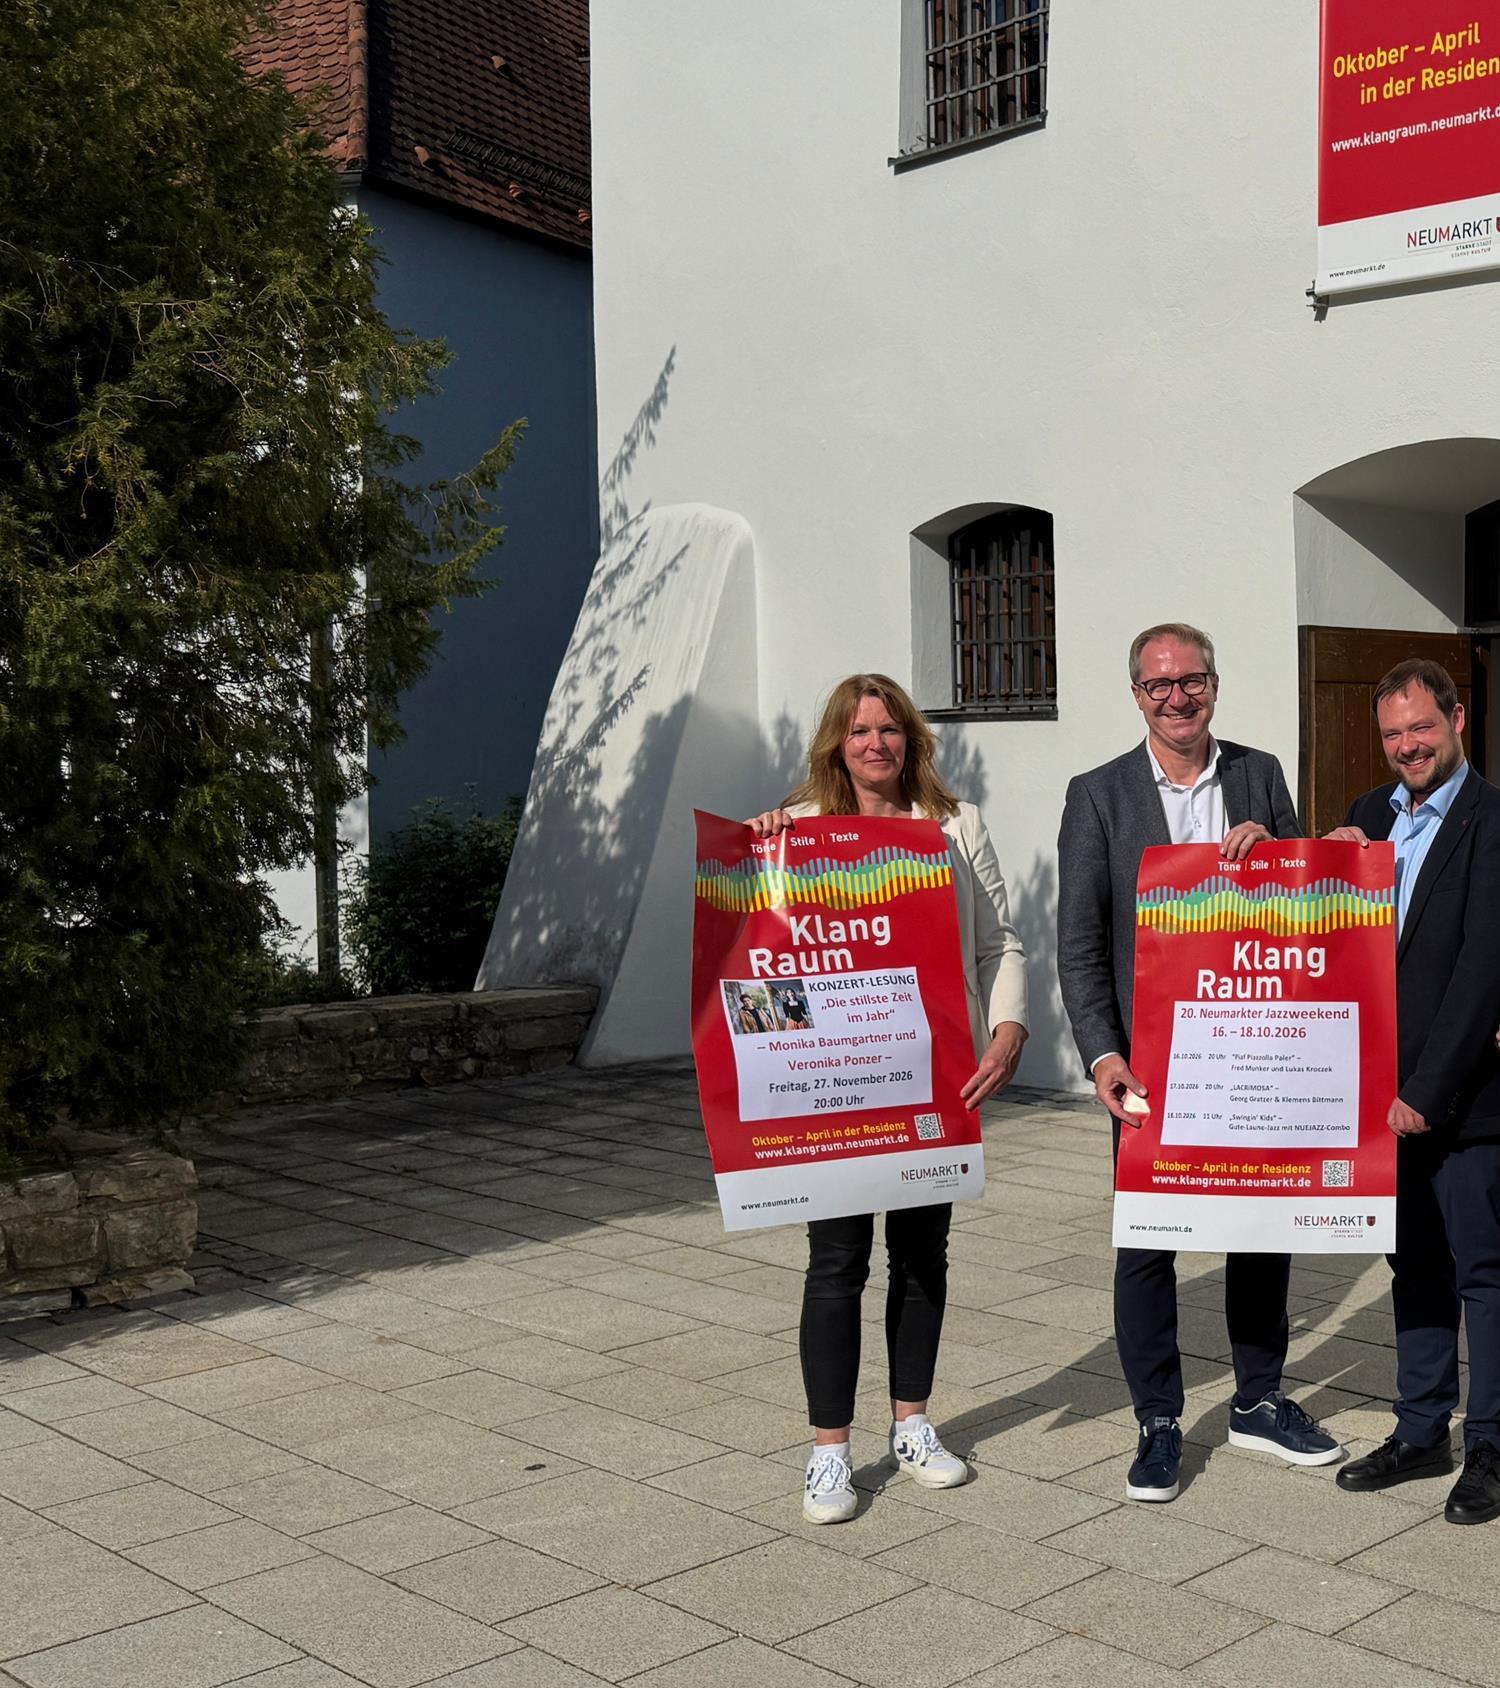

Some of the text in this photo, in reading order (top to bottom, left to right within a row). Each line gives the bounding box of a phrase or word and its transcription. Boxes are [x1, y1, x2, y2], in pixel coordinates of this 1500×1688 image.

[1333, 44, 1409, 78] Oktober
[1430, 22, 1480, 57] April
[1360, 84, 1377, 105] in
[1383, 77, 1415, 101] der
[1407, 218, 1493, 249] NEUMARKT
[1329, 263, 1385, 279] www.neumarkt.de
[751, 832, 860, 854] Töne Stile Texte
[1218, 858, 1307, 872] Töne Stile Texte
[788, 915, 891, 946] Klang
[748, 948, 854, 977] Raum
[1233, 941, 1326, 978] Klang
[808, 974, 915, 992] KONZERT-LESUNG
[1197, 969, 1282, 999] Raum
[821, 991, 913, 1010] „Die stillste Zeit
[847, 1012, 863, 1023] im
[1180, 1008, 1350, 1020] 20. Neumarkter Jazzweekend
[769, 1037, 815, 1052] Monika
[819, 1032, 892, 1047] Baumgartner
[895, 1029, 917, 1041] und
[1212, 1026, 1227, 1037] 16.
[1240, 1026, 1307, 1038] 18.10.2026
[788, 1057, 841, 1071] Veronika
[844, 1055, 882, 1067] Ponzer
[769, 1070, 913, 1093] Freitag, 27. November 2026
[814, 1094, 865, 1109] 20:00 Uhr
[752, 1134, 794, 1147] Oktober
[806, 1129, 831, 1144] April
[832, 1128, 842, 1138] in
[844, 1126, 861, 1137] der
[863, 1121, 906, 1135] Residenz
[754, 1133, 910, 1160] www.klangraum.neumarkt.de
[901, 1164, 959, 1182] NEUMARKT
[1153, 1160, 1191, 1172] Oktober
[1202, 1162, 1228, 1176] April
[1229, 1162, 1239, 1173] in
[1241, 1162, 1260, 1173] der
[1262, 1163, 1311, 1175] Residenz
[1152, 1174, 1312, 1189] www.klangraum.neumarkt.de
[741, 1196, 810, 1210] www.neumarkt.de
[1129, 1223, 1193, 1233] www.neumarkt.de
[1294, 1215, 1364, 1227] NEUMARKT
